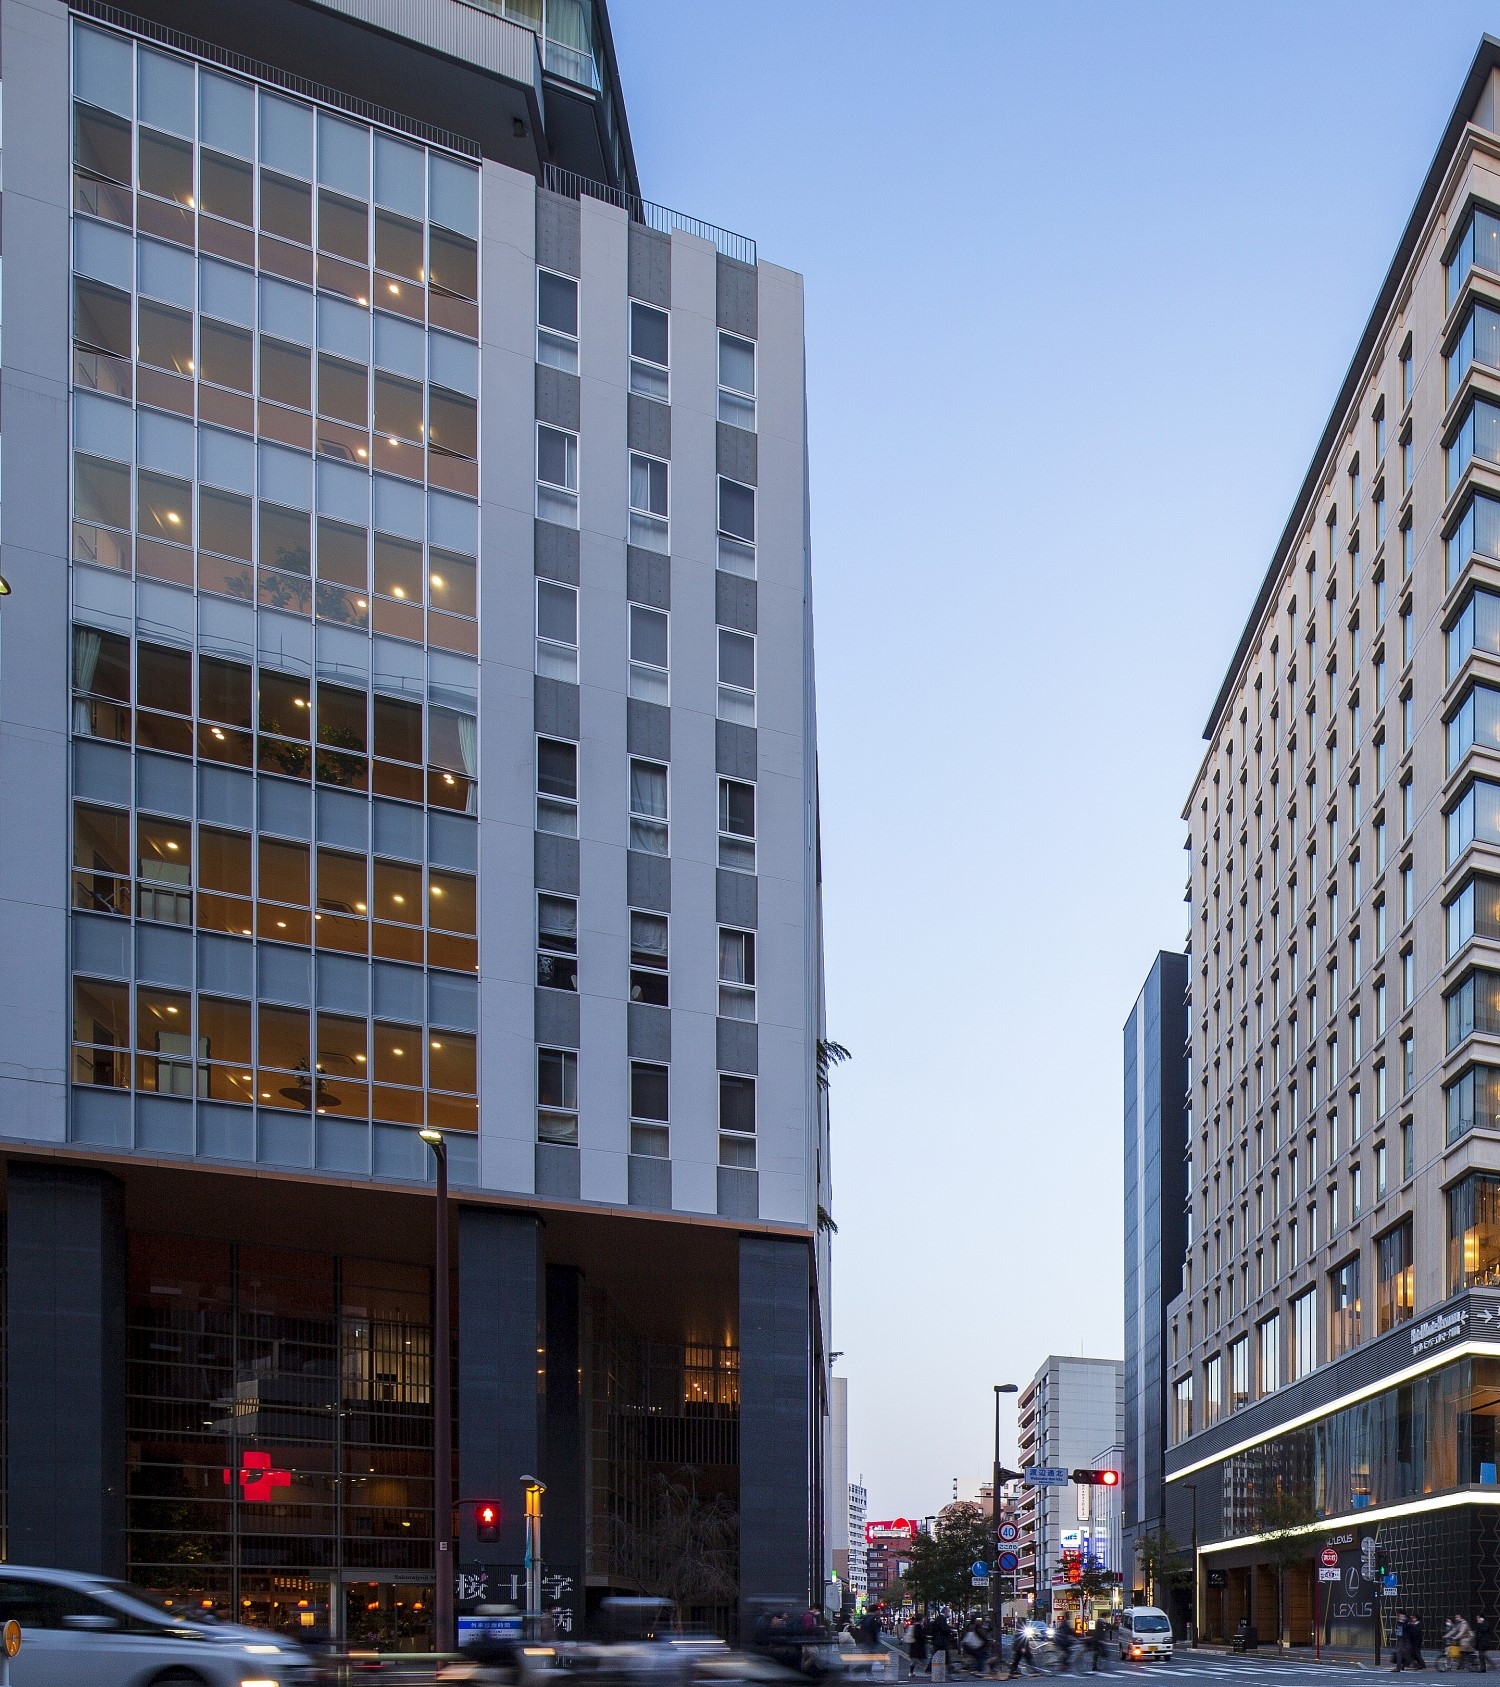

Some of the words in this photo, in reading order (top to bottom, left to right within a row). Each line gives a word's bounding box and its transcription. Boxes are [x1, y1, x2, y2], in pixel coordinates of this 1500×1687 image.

[1029, 1468, 1064, 1477] 渡辺通北
[1333, 1534, 1353, 1545] LEXUS
[456, 1574, 573, 1600] 桜十字
[1333, 1602, 1372, 1618] LEXUS
